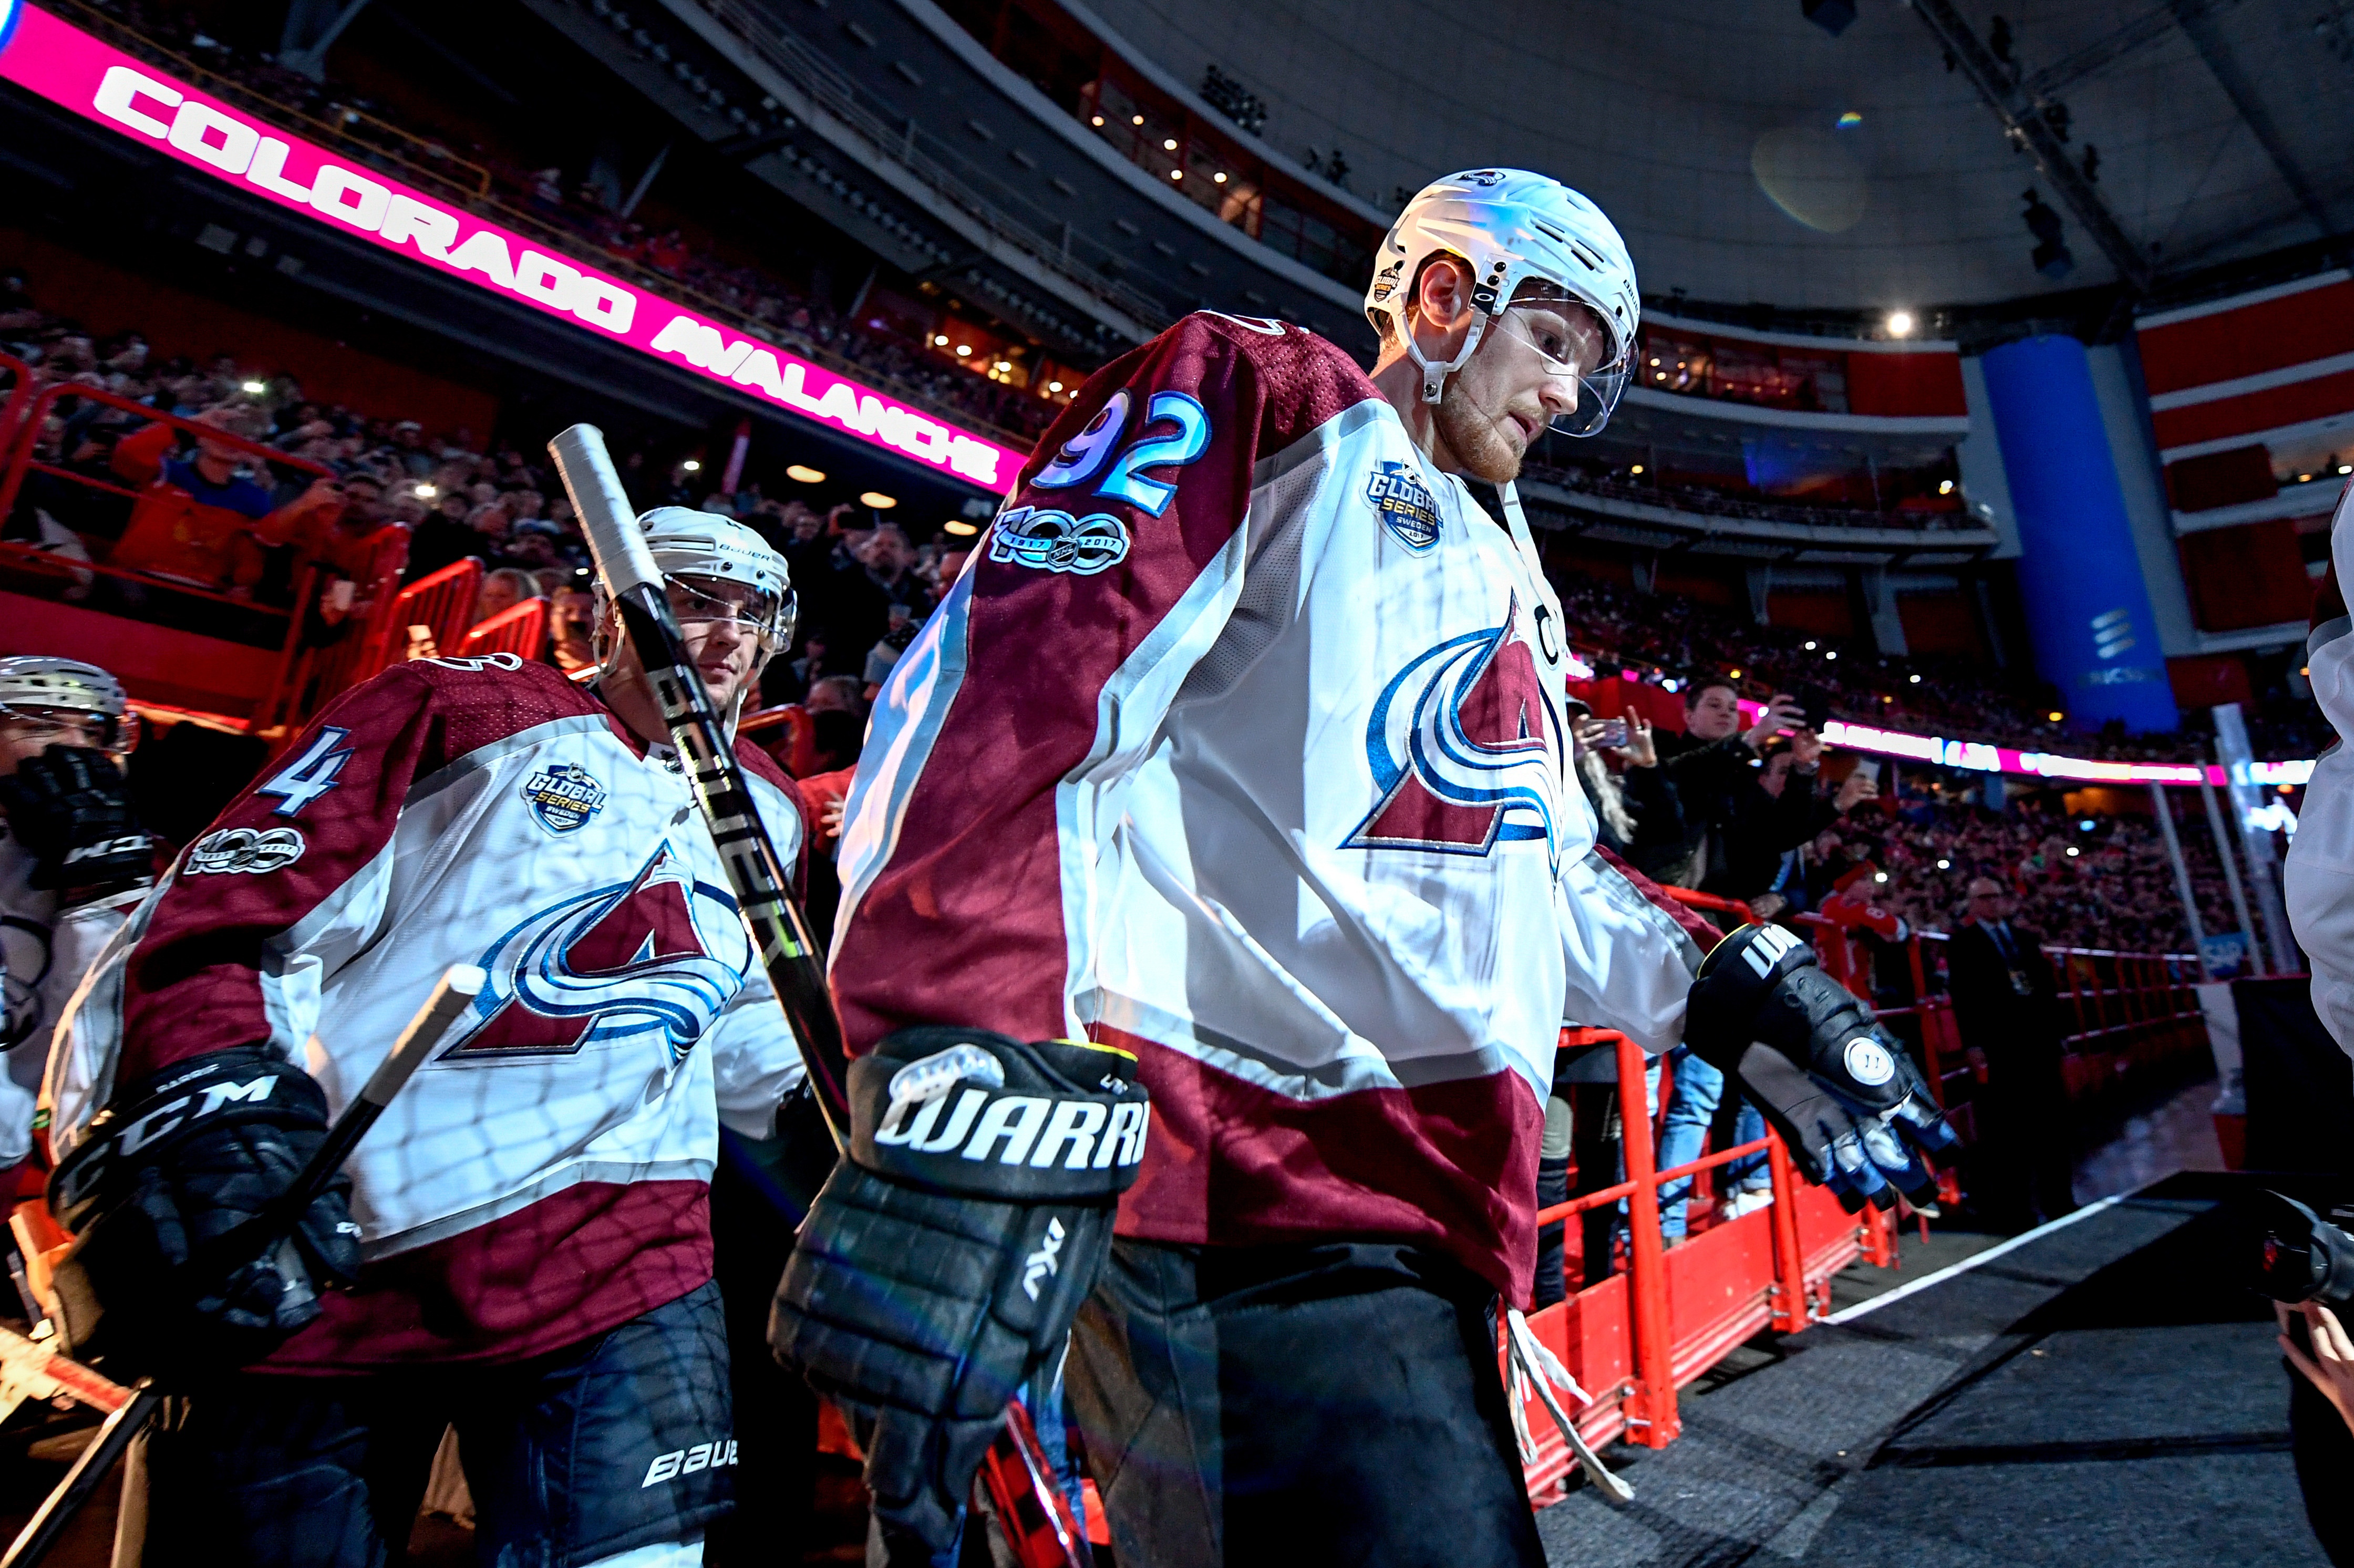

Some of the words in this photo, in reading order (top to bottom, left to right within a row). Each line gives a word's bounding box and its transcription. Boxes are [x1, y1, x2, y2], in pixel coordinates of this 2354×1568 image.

[93, 66, 636, 334] COLORADO
[651, 316, 1000, 484] AVALANCHE
[1623, 278, 1638, 316] BAUE
[1030, 388, 1212, 518] 92
[1368, 472, 1443, 522] GLOBAL
[1381, 498, 1436, 526] SERIES
[1396, 516, 1432, 533] SWEDEN
[1010, 536, 1046, 548] 1917
[1052, 544, 1075, 559] NHL
[1084, 538, 1117, 548] 2017
[258, 726, 354, 817] 4
[527, 772, 608, 810] GLOBAL
[535, 791, 592, 814] SERIES
[544, 805, 581, 820] SWEDEN
[58, 1075, 280, 1209] CCM
[874, 1088, 1151, 1170] WARRI
[641, 1439, 739, 1489] BAUE
